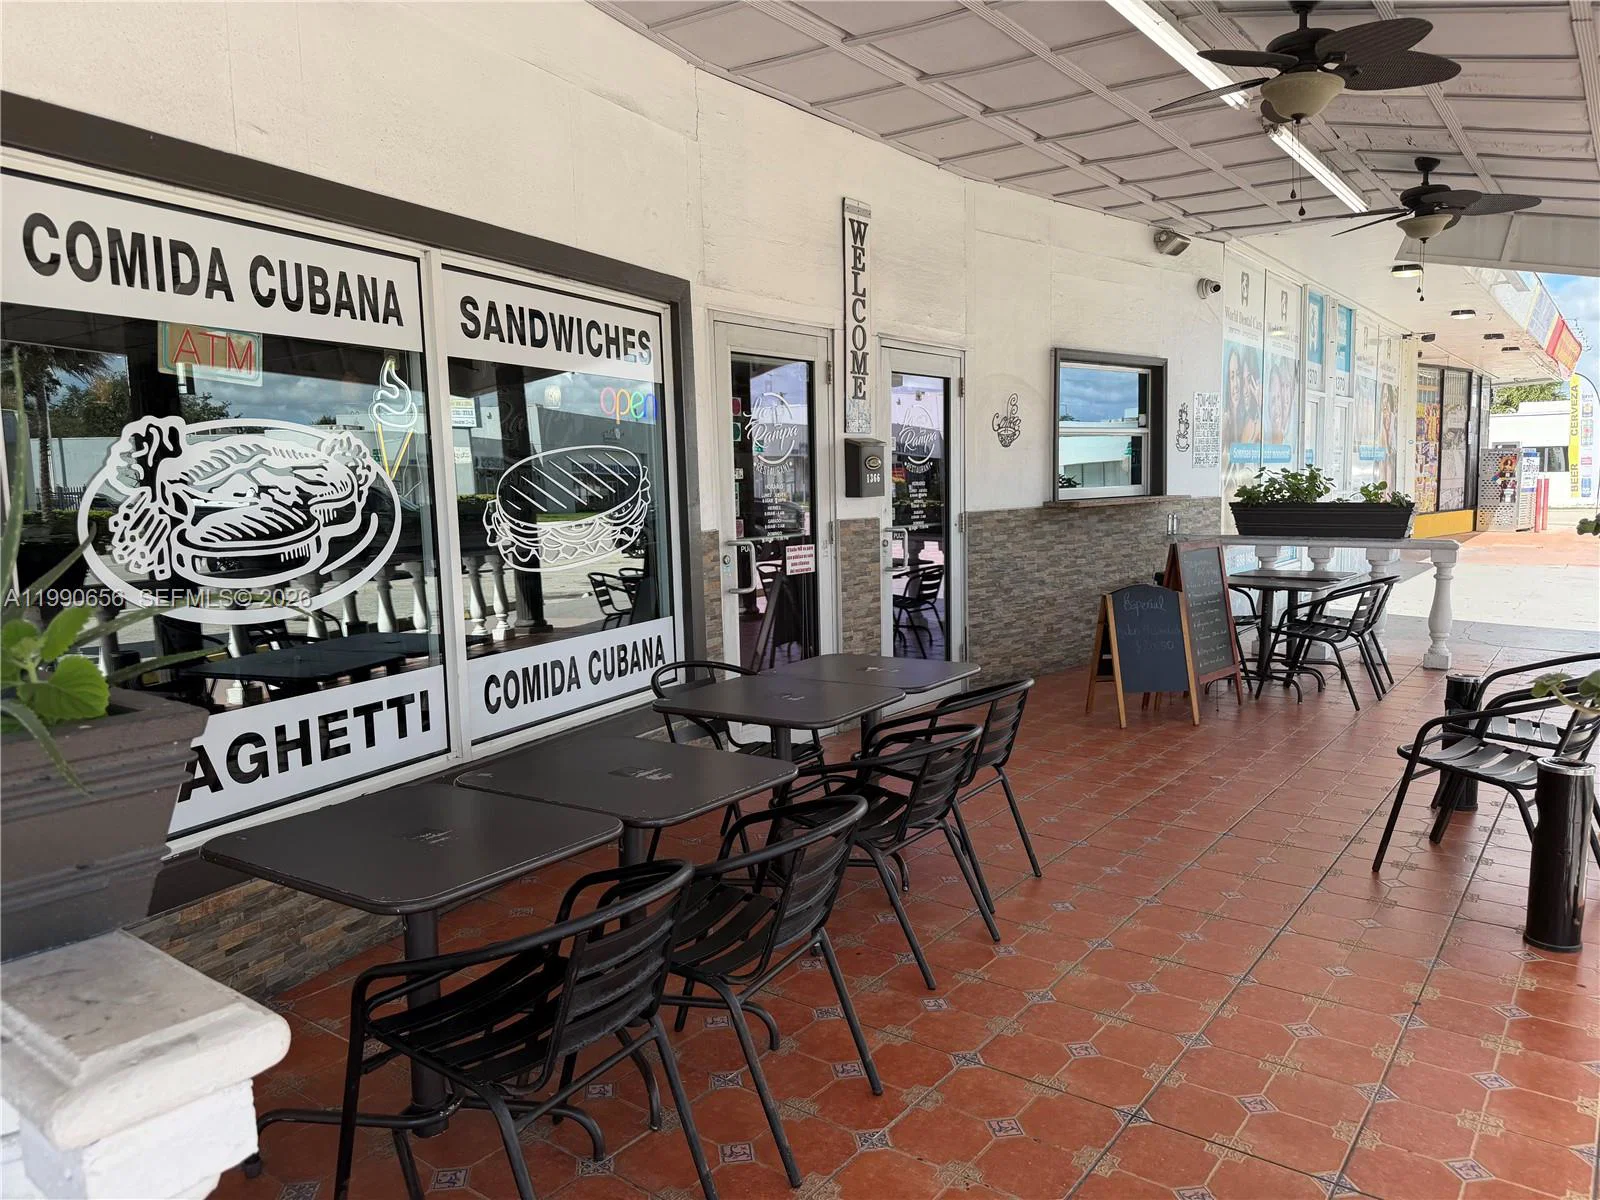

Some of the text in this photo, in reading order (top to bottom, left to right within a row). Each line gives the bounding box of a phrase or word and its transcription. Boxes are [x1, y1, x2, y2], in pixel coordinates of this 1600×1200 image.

[23, 212, 404, 327] COMIDA CUBANA
[459, 295, 652, 365] SANDWICHES
[848, 218, 869, 400] WELCOME
[172, 327, 252, 375] ATM
[600, 386, 657, 425] open
[1570, 384, 1579, 437] CERVEZA
[747, 419, 798, 450] Rampa
[900, 426, 937, 453] Rampa
[755, 460, 790, 475] RESTAURANT
[866, 473, 880, 483] 1366
[1570, 463, 1579, 492] BEER
[484, 635, 666, 714] COMIDA CUBANA
